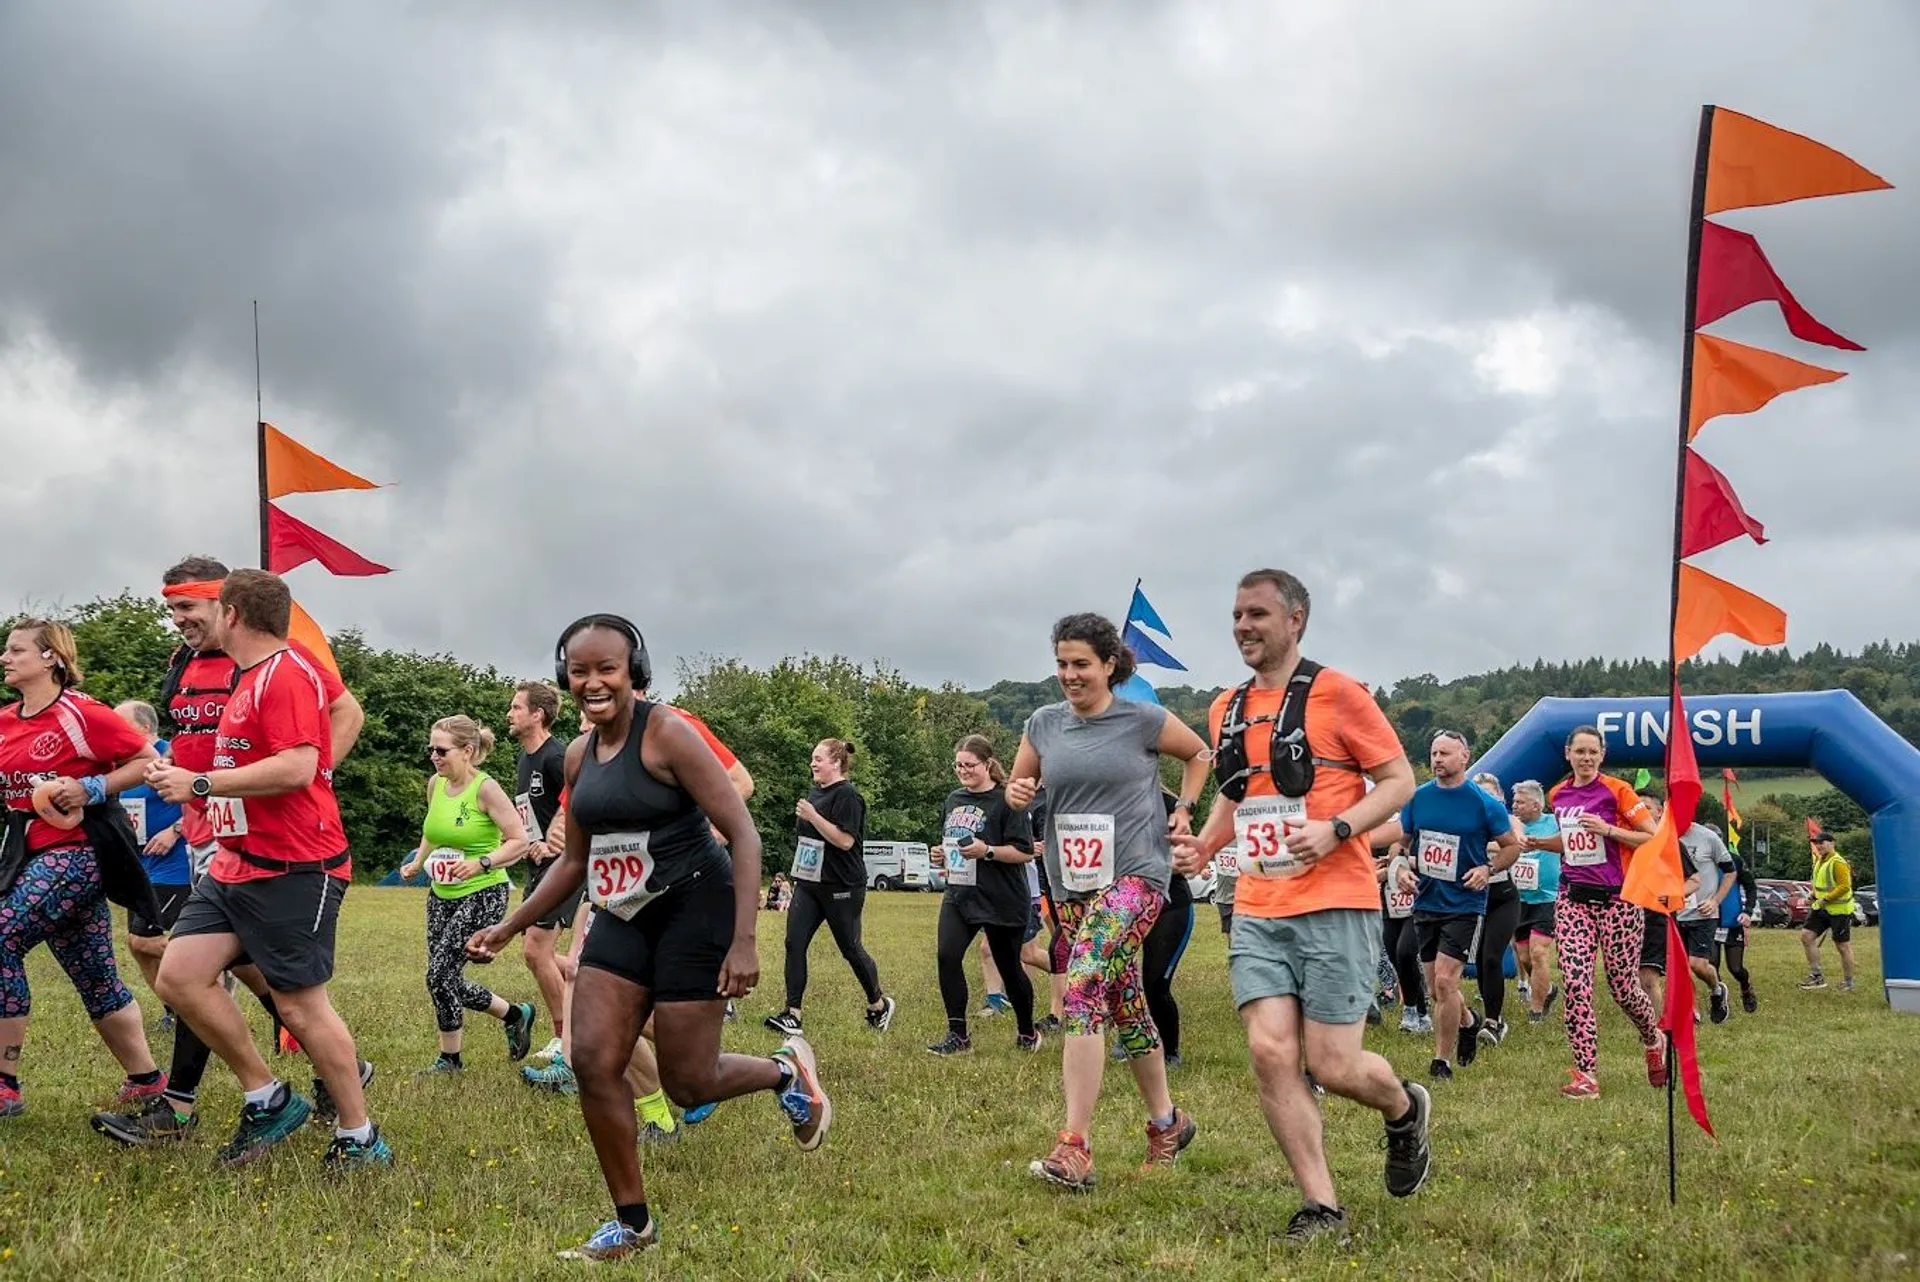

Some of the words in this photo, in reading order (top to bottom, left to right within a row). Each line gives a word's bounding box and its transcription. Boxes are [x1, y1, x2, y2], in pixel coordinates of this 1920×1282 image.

[1596, 708, 1762, 747] FINSH
[1279, 804, 1301, 814] BLAST
[621, 843, 641, 853] BLAST
[1567, 832, 1597, 851] 603
[1062, 837, 1103, 868] 532
[1424, 844, 1452, 867] 604
[593, 855, 644, 896] 329
[1514, 865, 1535, 880] 270
